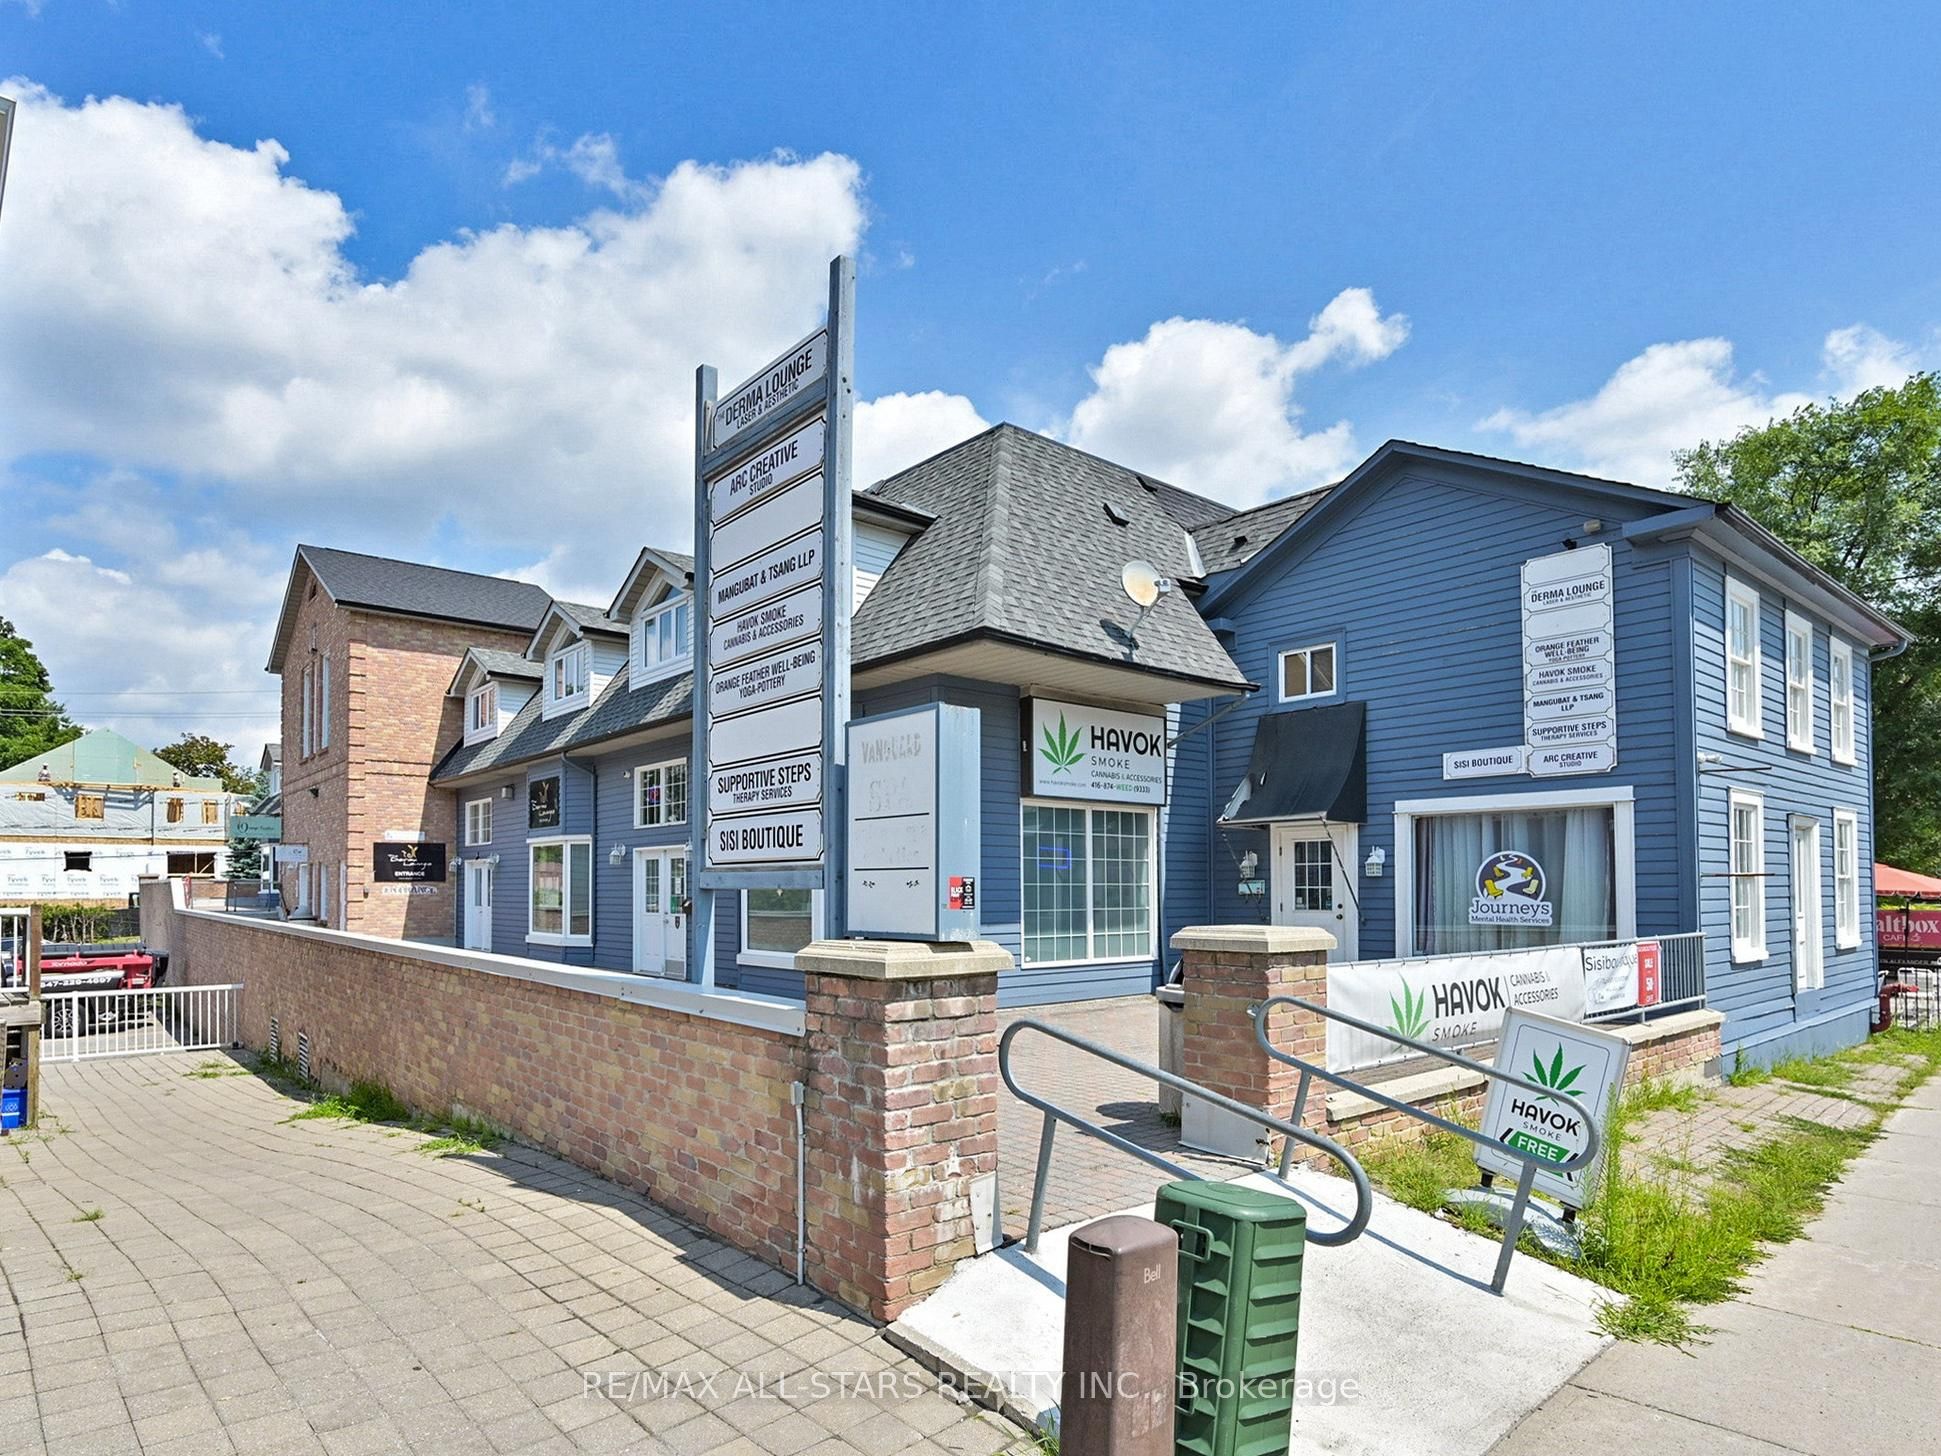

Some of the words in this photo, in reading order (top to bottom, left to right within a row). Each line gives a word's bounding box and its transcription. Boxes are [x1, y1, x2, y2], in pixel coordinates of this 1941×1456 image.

[726, 385, 763, 426] DERMA
[766, 348, 812, 398] LOUNGE
[737, 408, 757, 429] LASER
[758, 404, 763, 416] &
[764, 378, 799, 412] AESTHETIC
[730, 470, 748, 496] ARC
[750, 440, 798, 481] CREATIVE
[749, 473, 773, 496] STUDIO
[718, 574, 759, 605] MANGUBAT
[760, 569, 767, 584] &
[768, 558, 797, 580] TSANG
[798, 549, 815, 569] LLP
[1531, 589, 1564, 603] DERMA
[1567, 580, 1605, 596] LOUNGE
[1565, 593, 1592, 601] AESTHETIC
[737, 613, 758, 633] HAVOK
[760, 604, 787, 625] SMOKE
[723, 632, 751, 651] CANNABIS
[752, 629, 758, 641] &
[758, 614, 804, 639] ACCESSORIES
[1535, 642, 1565, 653] ORANGE
[1567, 637, 1599, 647] FEATHER
[1545, 645, 1589, 658] WELL-BEING
[715, 674, 740, 695] ORANGE
[741, 665, 770, 687] FEATHER
[770, 650, 816, 678] WELL-BEING
[1532, 678, 1558, 686] CANNABIS
[1566, 673, 1603, 682] ACCESSORIES
[1539, 669, 1566, 679] HAVOK
[1567, 665, 1597, 675] SMOKE
[739, 677, 785, 699] YOGA-POTTERY
[1533, 696, 1570, 707] MANGUBAT
[1580, 692, 1604, 701] TSANG
[1532, 724, 1579, 736] SUPPORTIVE
[1581, 721, 1607, 731] STEPS
[1569, 730, 1598, 738] SERVICES
[1090, 725, 1162, 758] HAVOK
[1091, 756, 1130, 769] SMOKE
[1454, 760, 1470, 769] SISI
[1472, 755, 1513, 767] BOUTIQUE
[1543, 754, 1559, 763] ARC
[1561, 751, 1598, 761] CREATIVE
[1559, 760, 1582, 768] STUDIO
[717, 768, 776, 795] SUPPORTIVE
[778, 762, 812, 784] STEPS
[1091, 770, 1120, 780] CANNABIS
[1126, 775, 1162, 785] ACCESSORIES
[733, 789, 759, 804] THERAPY
[760, 785, 792, 801] SERVICES
[720, 830, 739, 851] SISI
[742, 824, 804, 851] BOUTIQUE
[1472, 900, 1550, 917] Journeys
[1520, 916, 1550, 924] Services
[1510, 971, 1545, 987] CANNABIS
[1432, 977, 1505, 1018] HAVOK
[1514, 987, 1559, 1006] ACCESSORIES
[1432, 1022, 1477, 1041] SMOKE
[1511, 1098, 1580, 1136] HAVOK
[1523, 1121, 1561, 1141] SMOKE
[1517, 1135, 1558, 1161] FREE
[1143, 1263, 1161, 1284] Bell
